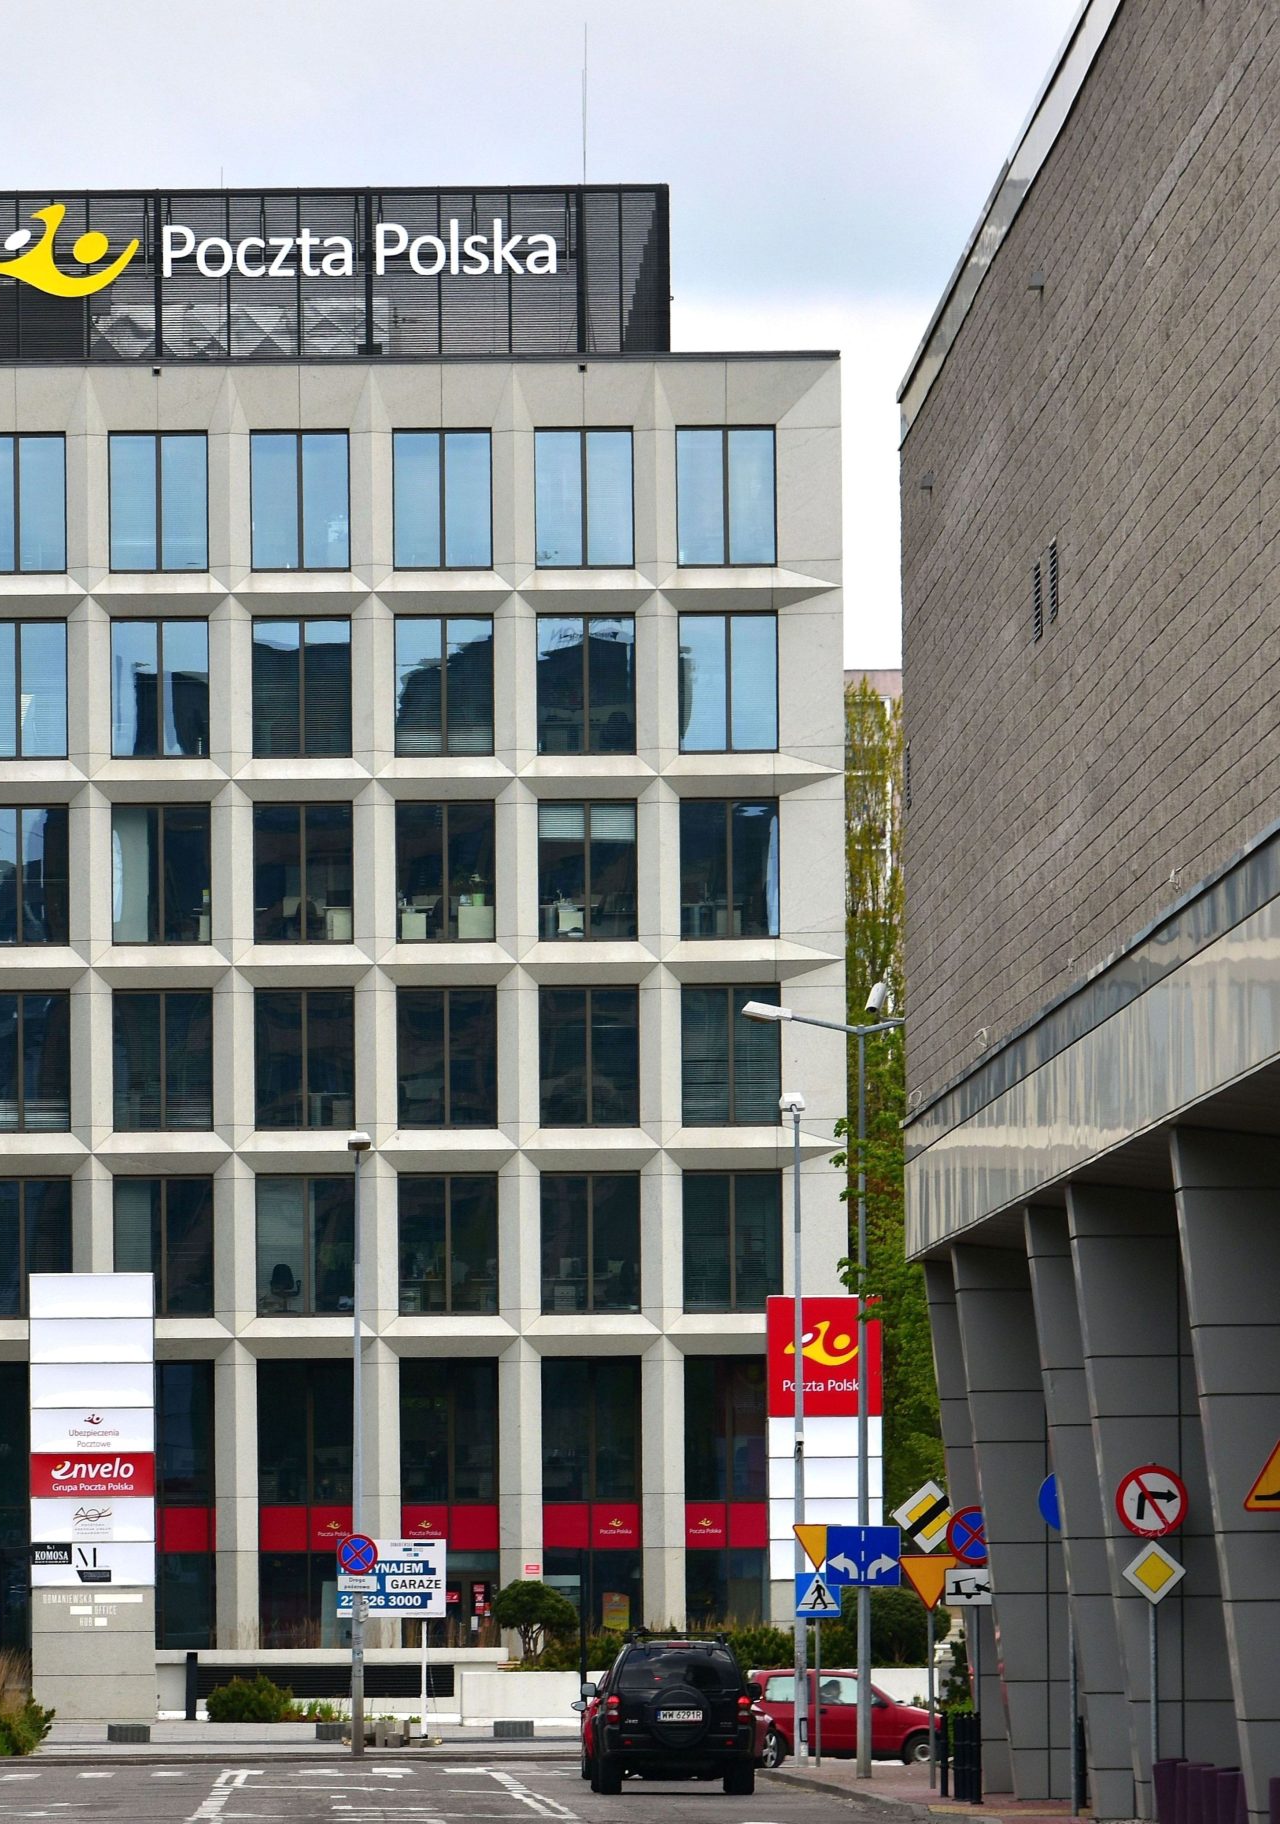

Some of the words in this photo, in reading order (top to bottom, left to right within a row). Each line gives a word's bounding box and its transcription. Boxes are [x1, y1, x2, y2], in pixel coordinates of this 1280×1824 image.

[162, 224, 354, 278] Poczta
[376, 218, 559, 276] Polska
[827, 1378, 859, 1392] Polsk
[68, 1429, 120, 1438] Ubezpieczenia
[76, 1440, 111, 1448] Pocztowe
[51, 1457, 134, 1480] envelo
[52, 1483, 78, 1492] Grupa
[79, 1483, 107, 1491] Poczta
[107, 1482, 134, 1491] Polska
[34, 1550, 69, 1561] KOMOSA
[390, 1577, 442, 1590] GARAŻE
[42, 1593, 92, 1604] DOMANIEWSKA
[388, 1595, 422, 1606] 3000
[94, 1605, 117, 1615] OFFICE
[662, 1711, 674, 1719] WW
[676, 1711, 702, 1719] 6291R
